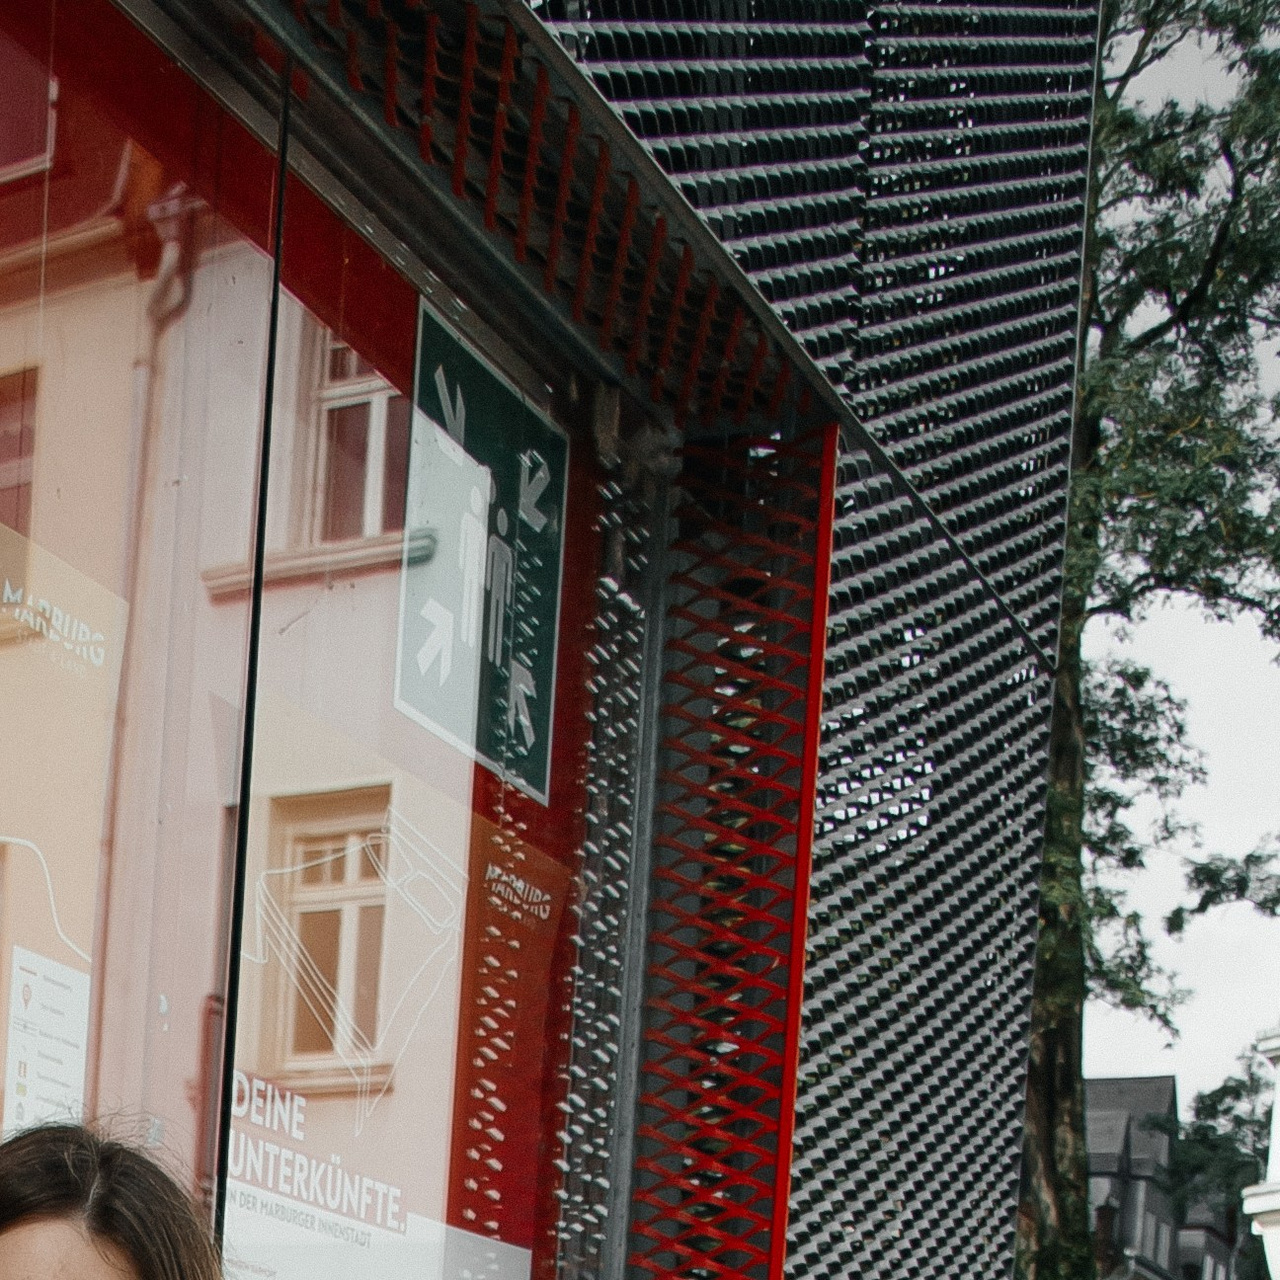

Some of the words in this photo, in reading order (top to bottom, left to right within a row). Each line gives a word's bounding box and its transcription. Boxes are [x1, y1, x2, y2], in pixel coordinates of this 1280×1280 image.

[231, 1070, 307, 1140] DEINE
[228, 1129, 405, 1232] UNTERKÜNFTE.
[260, 1199, 316, 1232] MARBURGER
